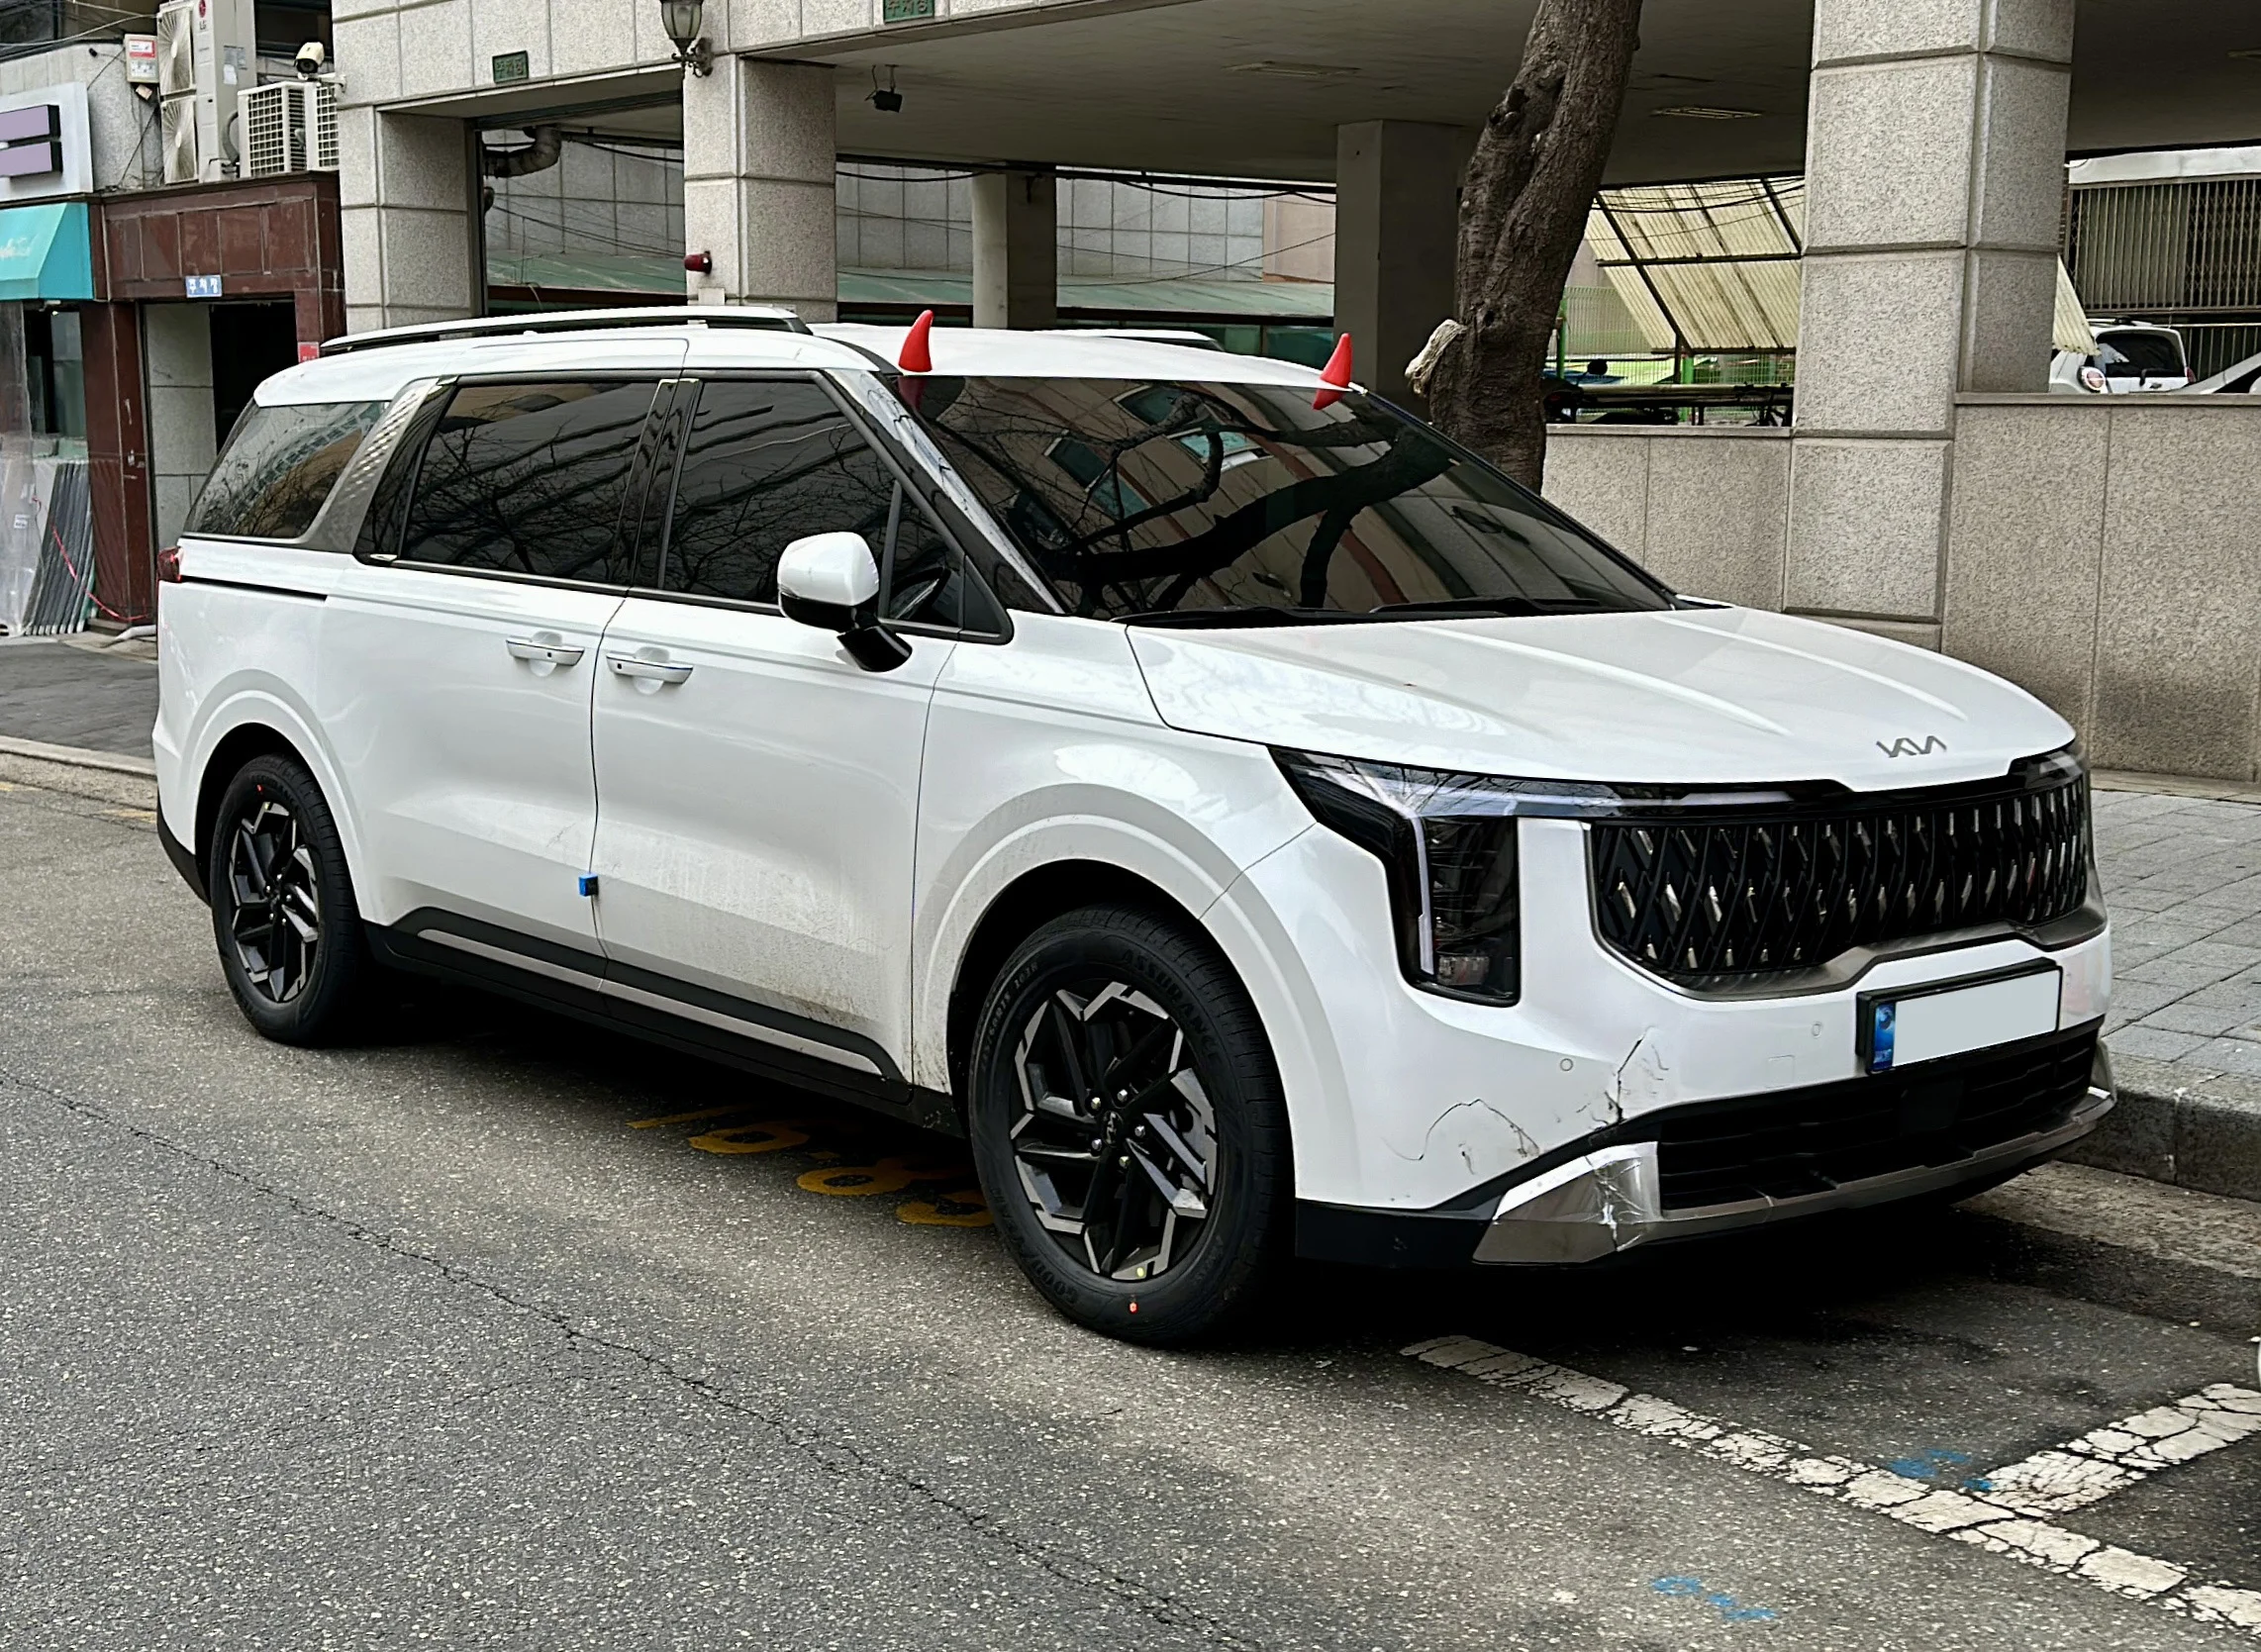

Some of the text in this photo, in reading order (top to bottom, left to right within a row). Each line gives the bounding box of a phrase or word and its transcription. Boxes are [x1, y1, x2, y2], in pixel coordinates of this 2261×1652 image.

[187, 276, 219, 294] 주차장
[1875, 735, 1947, 757] KIA
[1121, 947, 1222, 1060] ASSURANCE
